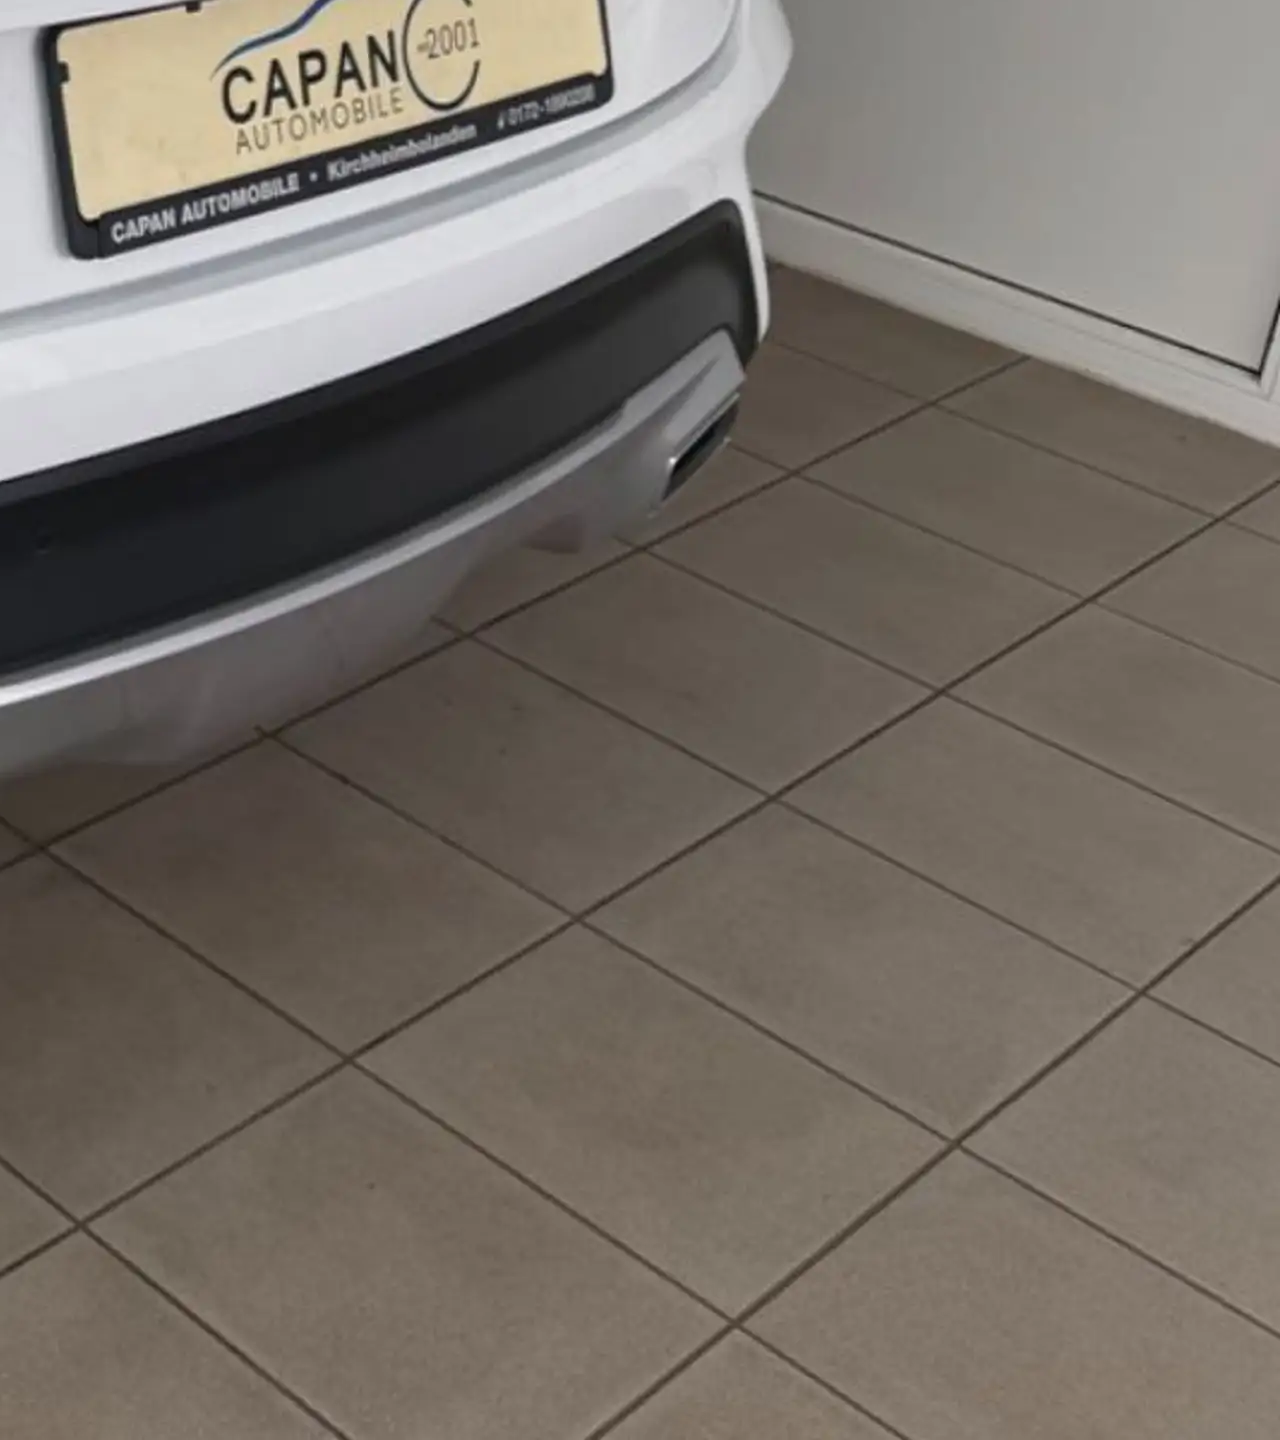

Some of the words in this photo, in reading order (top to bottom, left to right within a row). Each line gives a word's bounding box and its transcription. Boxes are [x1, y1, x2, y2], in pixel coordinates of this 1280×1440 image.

[222, 29, 400, 125] CAPAN
[235, 87, 406, 156] AUTOMOBILE
[111, 207, 176, 244] CAPAN
[180, 171, 302, 226] AUTOMOBILE
